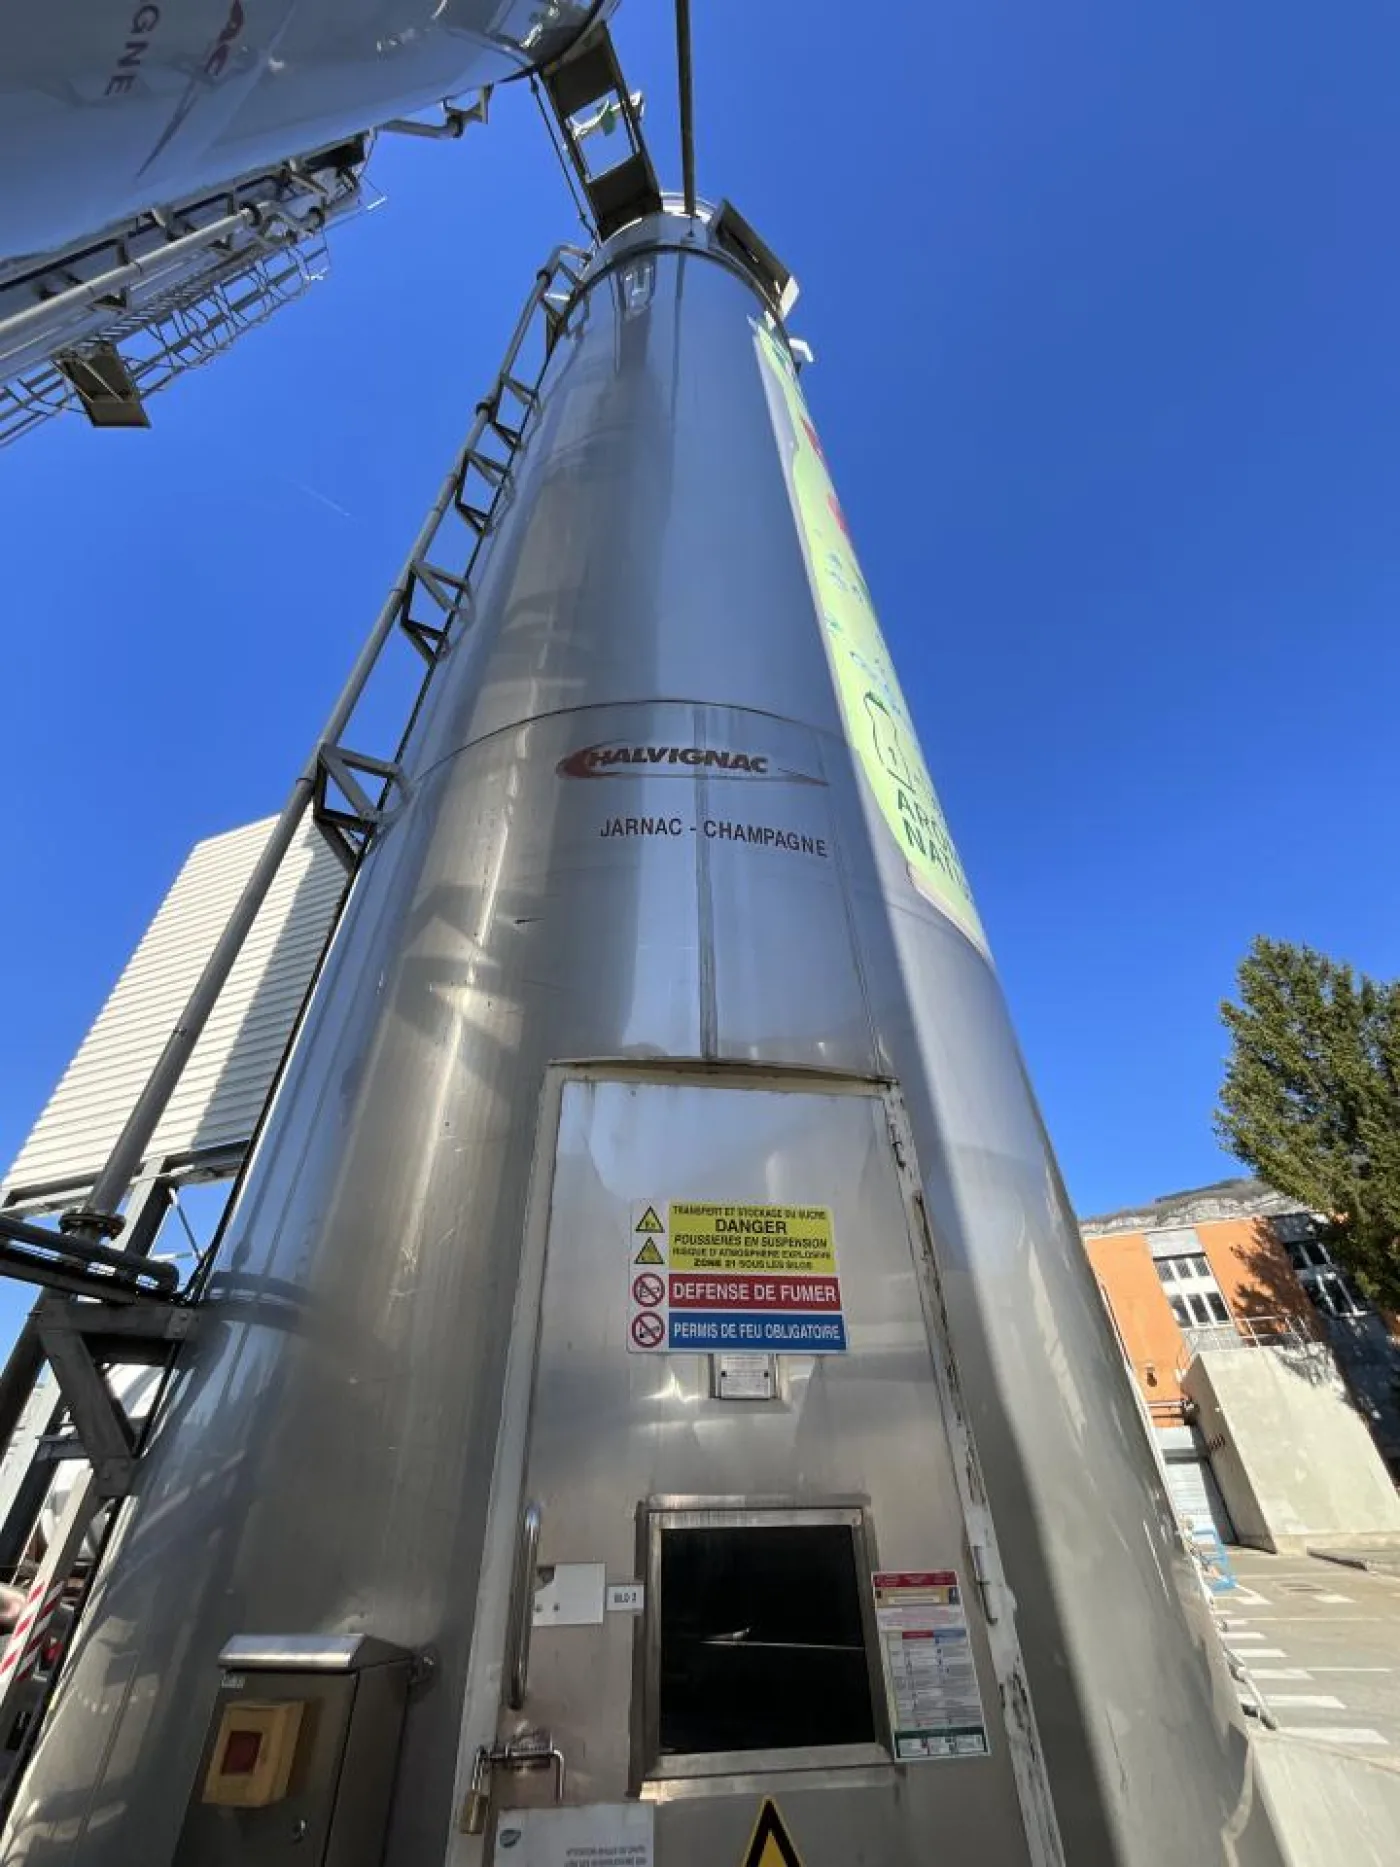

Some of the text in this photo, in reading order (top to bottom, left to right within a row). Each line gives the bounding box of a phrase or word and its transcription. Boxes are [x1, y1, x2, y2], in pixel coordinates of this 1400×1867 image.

[104, 0, 159, 95] GNE
[600, 817, 682, 837] JARNAC
[703, 819, 828, 858] CHAMPAGNE
[725, 1207, 736, 1217] ET
[738, 1207, 783, 1219] STOCKAGE
[715, 1217, 787, 1235] DANGER
[674, 1234, 828, 1249] POUSSIERES EN SUSPENSION
[693, 1257, 722, 1267] ZONE
[673, 1282, 837, 1303] DEFENSE DE FUMER
[673, 1321, 841, 1341] PERMIS DE FEU OBLIGATOIRE
